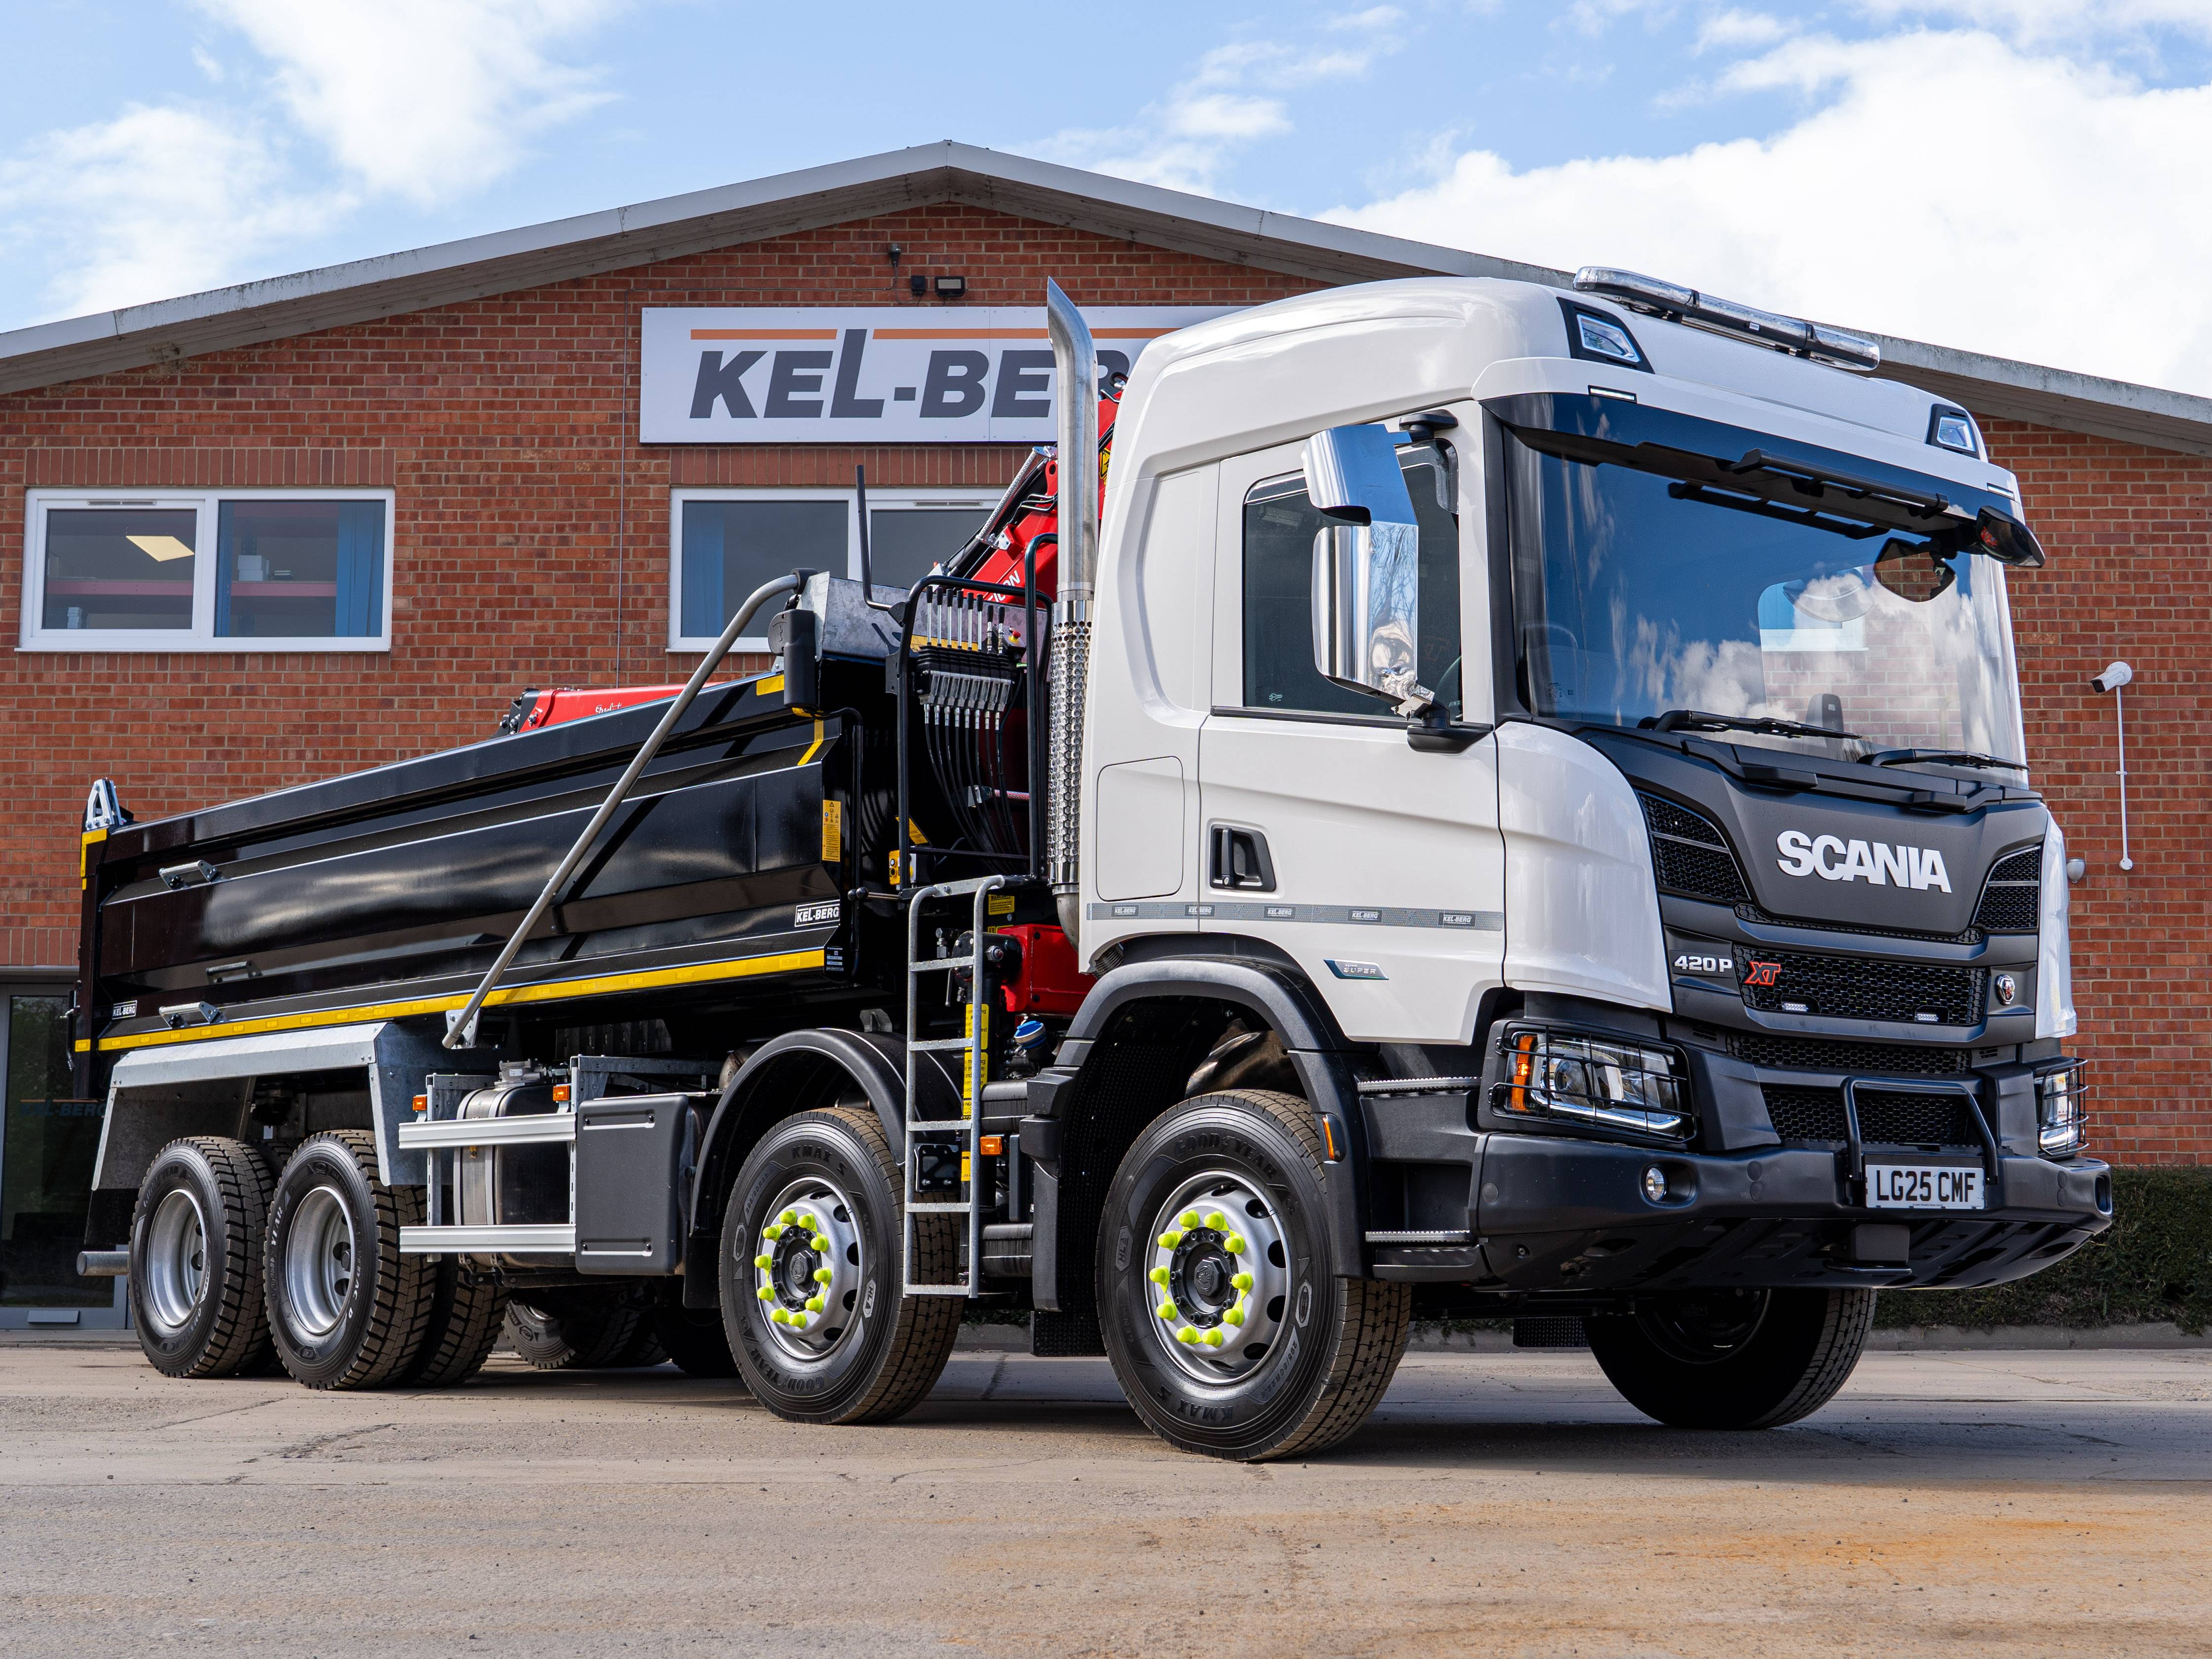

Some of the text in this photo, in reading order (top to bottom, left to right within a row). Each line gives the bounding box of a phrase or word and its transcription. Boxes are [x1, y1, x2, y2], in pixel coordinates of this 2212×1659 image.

[1776, 830, 1952, 894] SCANIA
[796, 906, 839, 923] KEL-BERG
[1674, 955, 1716, 972] 420
[1745, 961, 1781, 985] XT
[112, 1006, 135, 1017] KEL-BERG
[792, 1144, 832, 1164] KMAX
[1876, 1170, 1976, 1202] LG25 CMF
[1118, 1236, 1128, 1263] HLA
[865, 1286, 874, 1311] HLA
[1177, 1398, 1233, 1422] KMAX
